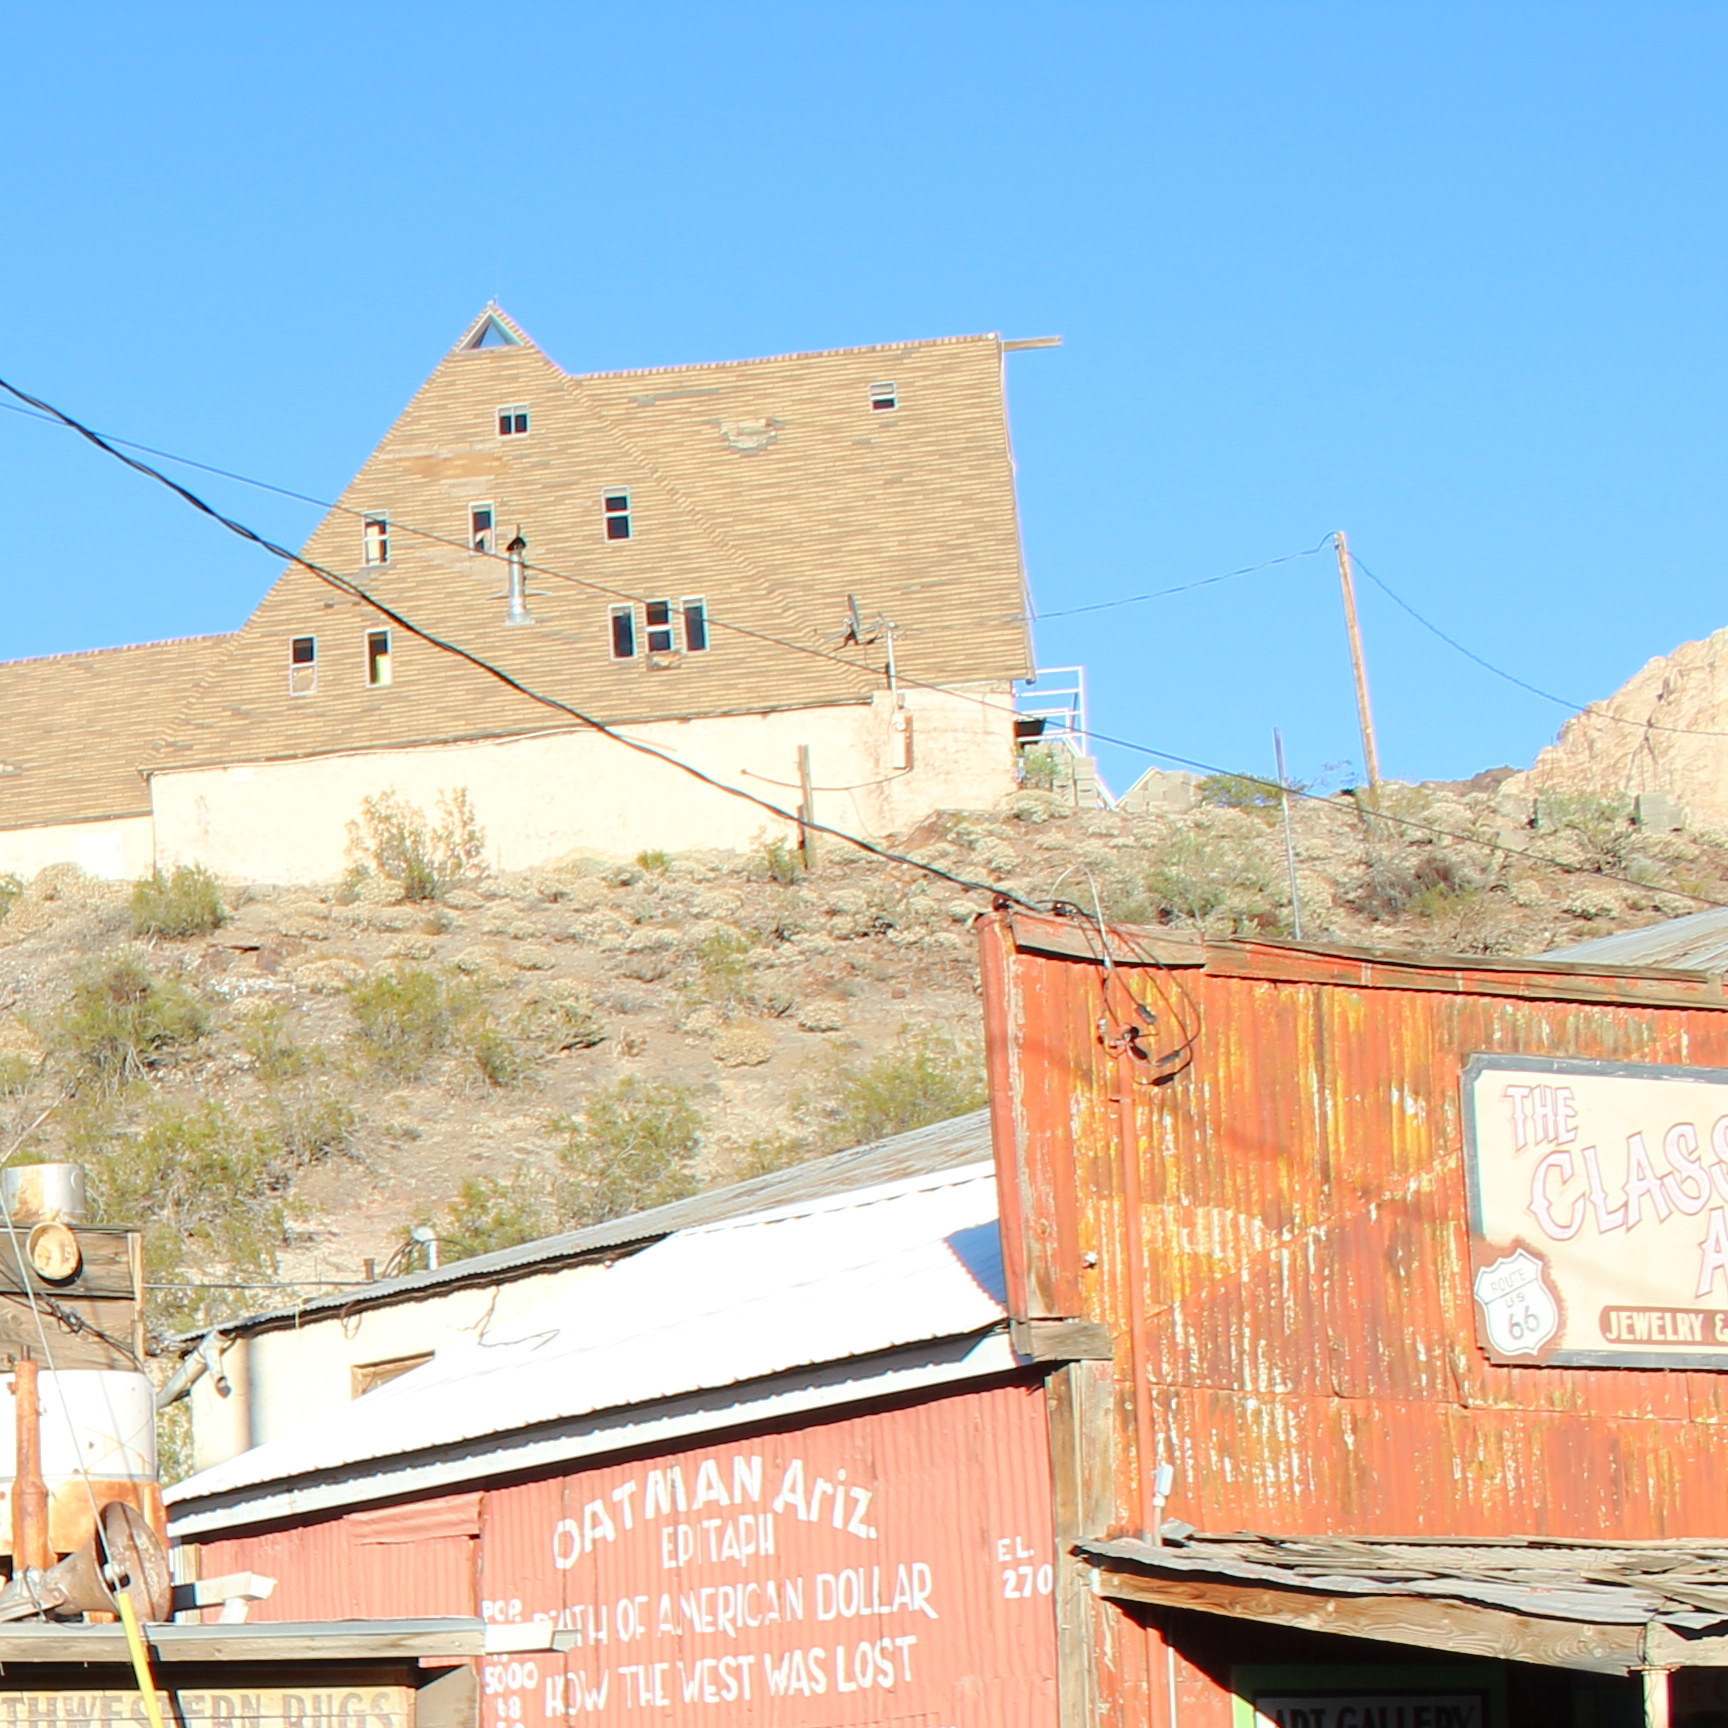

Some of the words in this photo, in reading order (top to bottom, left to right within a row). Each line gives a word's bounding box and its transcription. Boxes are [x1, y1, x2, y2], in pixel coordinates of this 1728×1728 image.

[1502, 1083, 1580, 1154] THE
[1490, 1267, 1527, 1295] ROUTE
[1507, 1305, 1541, 1341] 66
[1604, 1310, 1704, 1342] JEWELRY
[553, 1455, 764, 1570] OATMAN
[661, 1513, 775, 1568] EPITAPH
[617, 1595, 650, 1643] OF
[657, 1576, 803, 1638] AMERICAN
[816, 1562, 939, 1621] DOLLAR
[483, 1661, 539, 1695] 5000
[545, 1670, 610, 1719] HOW
[618, 1662, 669, 1708] THE
[678, 1655, 754, 1705] WEST
[763, 1646, 827, 1698] WAS
[835, 1635, 918, 1694] LOST
